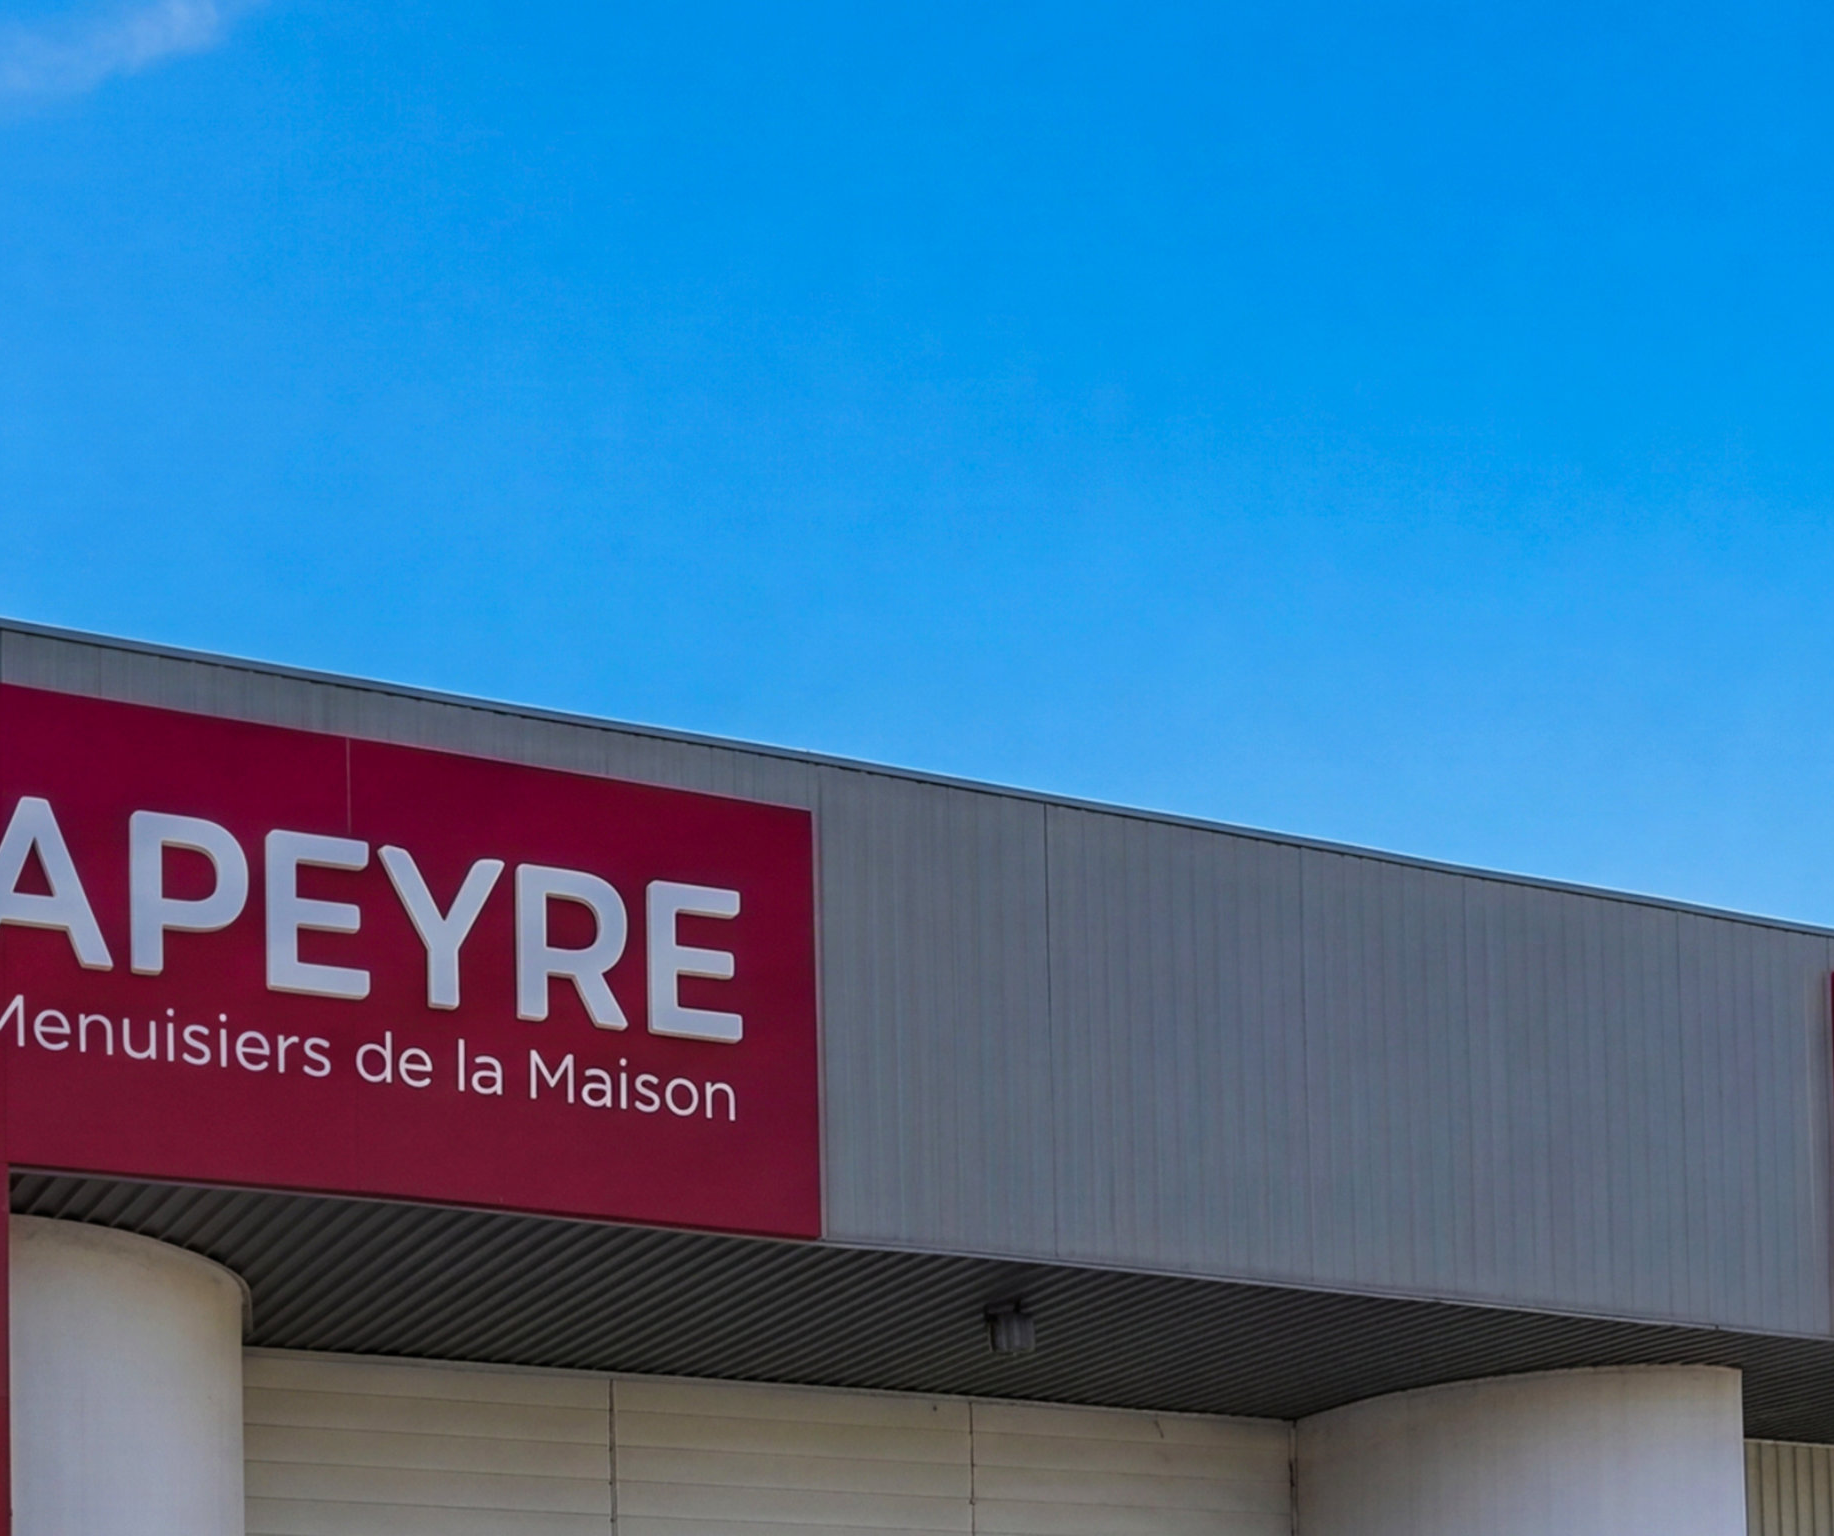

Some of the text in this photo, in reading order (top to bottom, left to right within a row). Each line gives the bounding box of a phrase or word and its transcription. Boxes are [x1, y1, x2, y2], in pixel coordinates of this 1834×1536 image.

[355, 1031, 433, 1088] de
[457, 1038, 503, 1096] la
[529, 1049, 737, 1122] Maison
